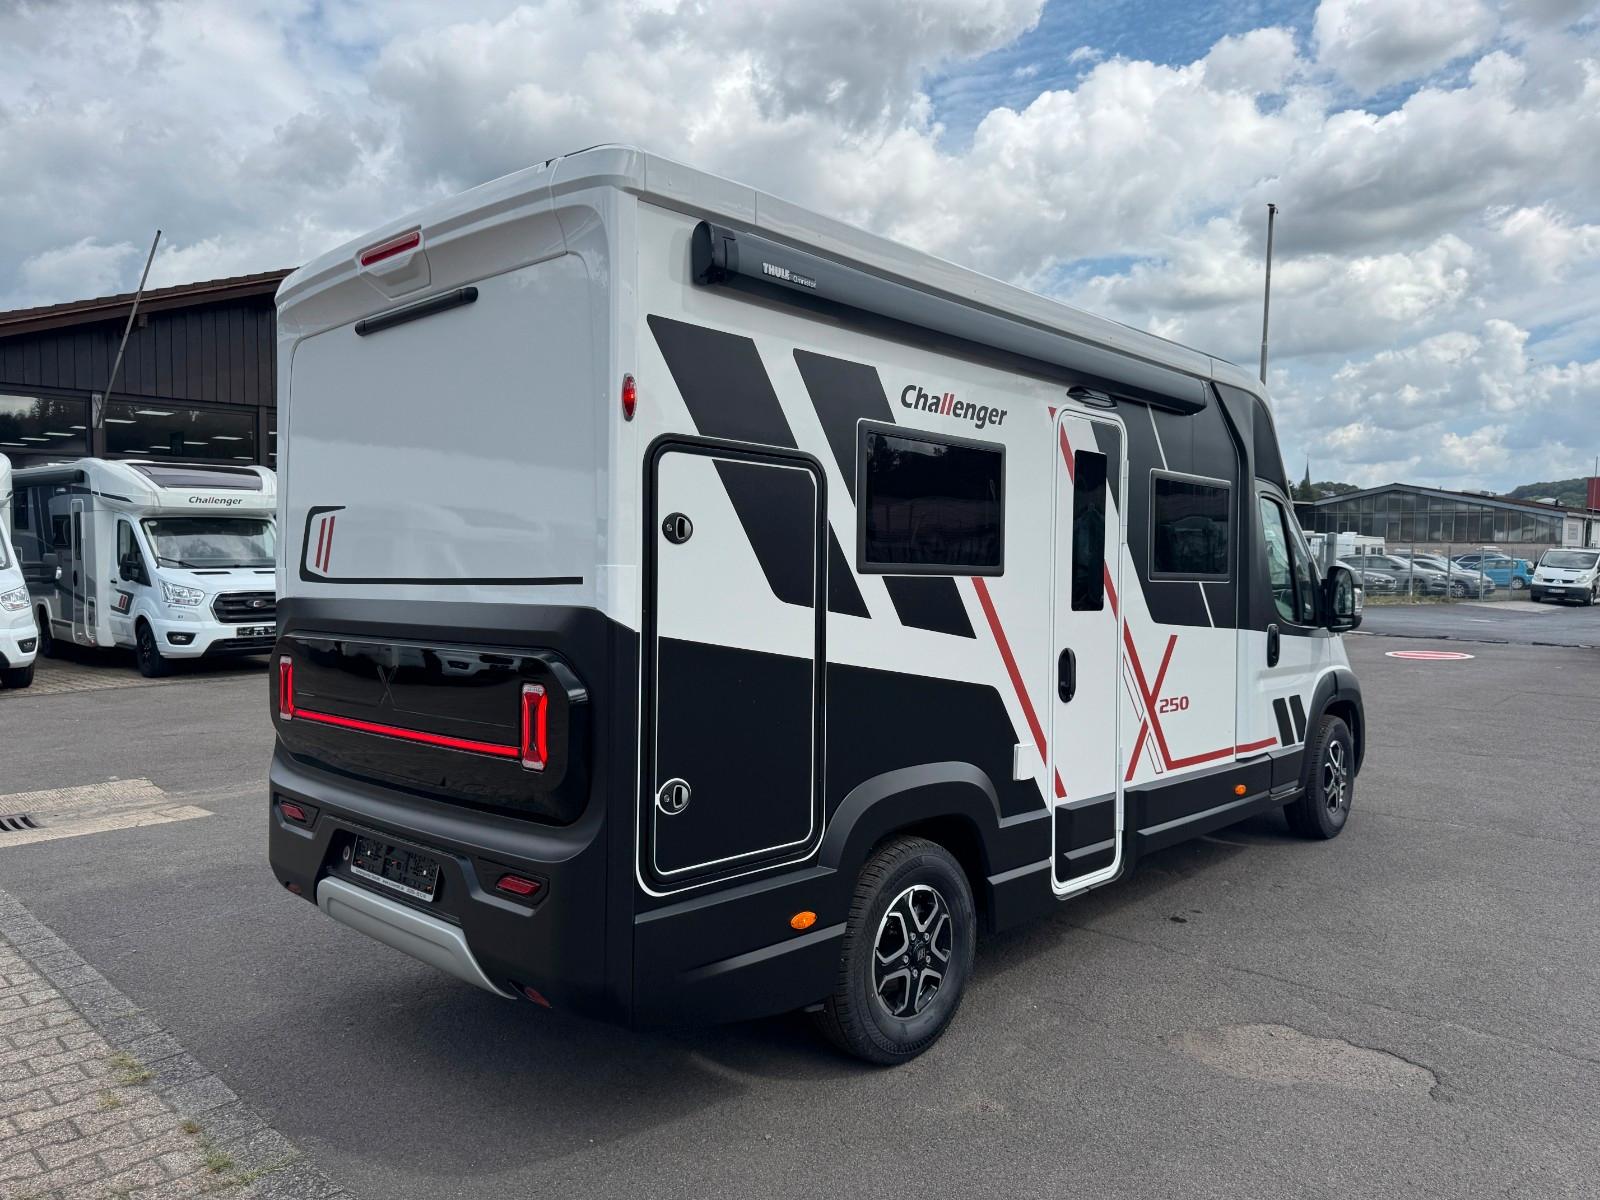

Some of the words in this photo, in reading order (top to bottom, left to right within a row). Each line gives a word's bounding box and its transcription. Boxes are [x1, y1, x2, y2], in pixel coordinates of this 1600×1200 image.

[762, 262, 791, 281] THULE
[900, 384, 1008, 430] Challenger
[188, 496, 243, 507] Challenger
[1159, 695, 1190, 714] 250
